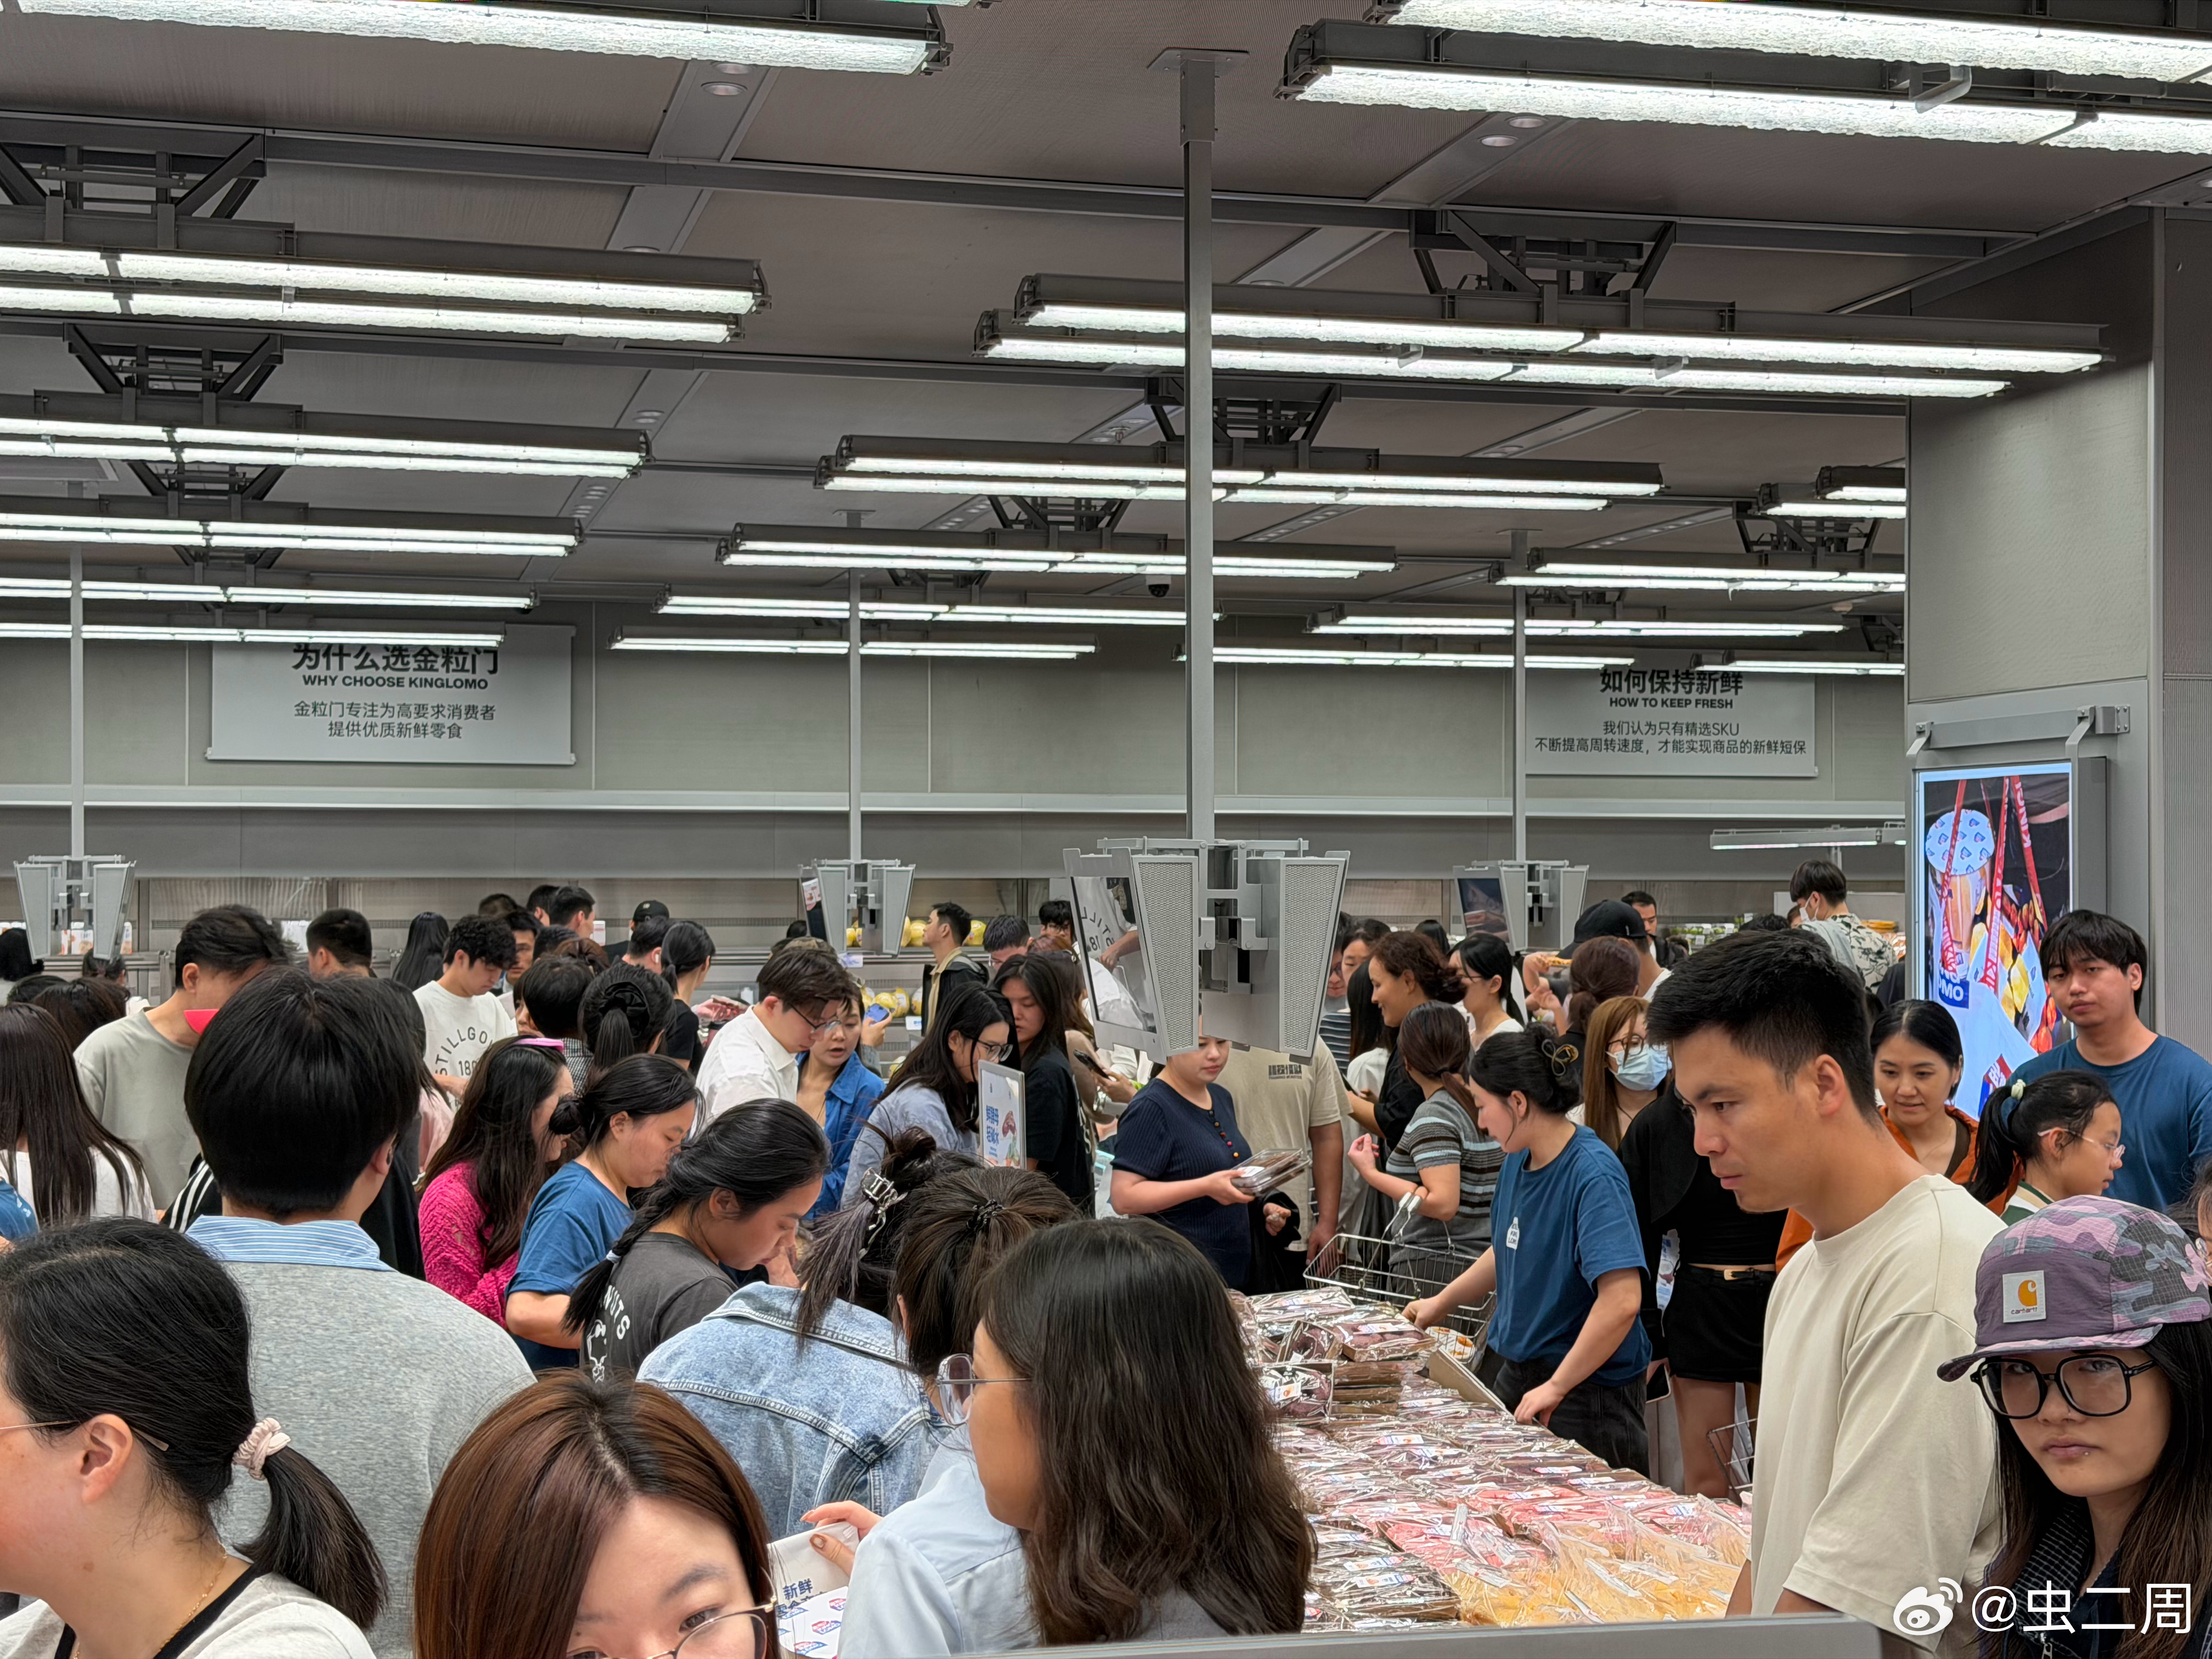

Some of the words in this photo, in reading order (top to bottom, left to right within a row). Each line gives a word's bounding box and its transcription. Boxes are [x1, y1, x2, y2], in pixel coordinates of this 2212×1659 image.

[292, 644, 498, 675] 为什么选金粒门
[302, 675, 338, 686] WHY
[342, 675, 405, 687] CHOOSE
[409, 677, 488, 690] KINGLOMO
[1600, 668, 1743, 696] 如何保持新鲜
[294, 701, 496, 720] 金粒门专注为高要求消费者
[1610, 697, 1639, 708] HOW
[1642, 698, 1658, 708] TO
[1661, 698, 1691, 708] KEEP
[1695, 699, 1733, 709] FRESH
[328, 720, 462, 739] 提供优质新鲜零食
[1602, 720, 1740, 736] 我们认为只有精选SKU
[603, 1285, 630, 1340] NUTS
[782, 1578, 813, 1600] 新鲜
